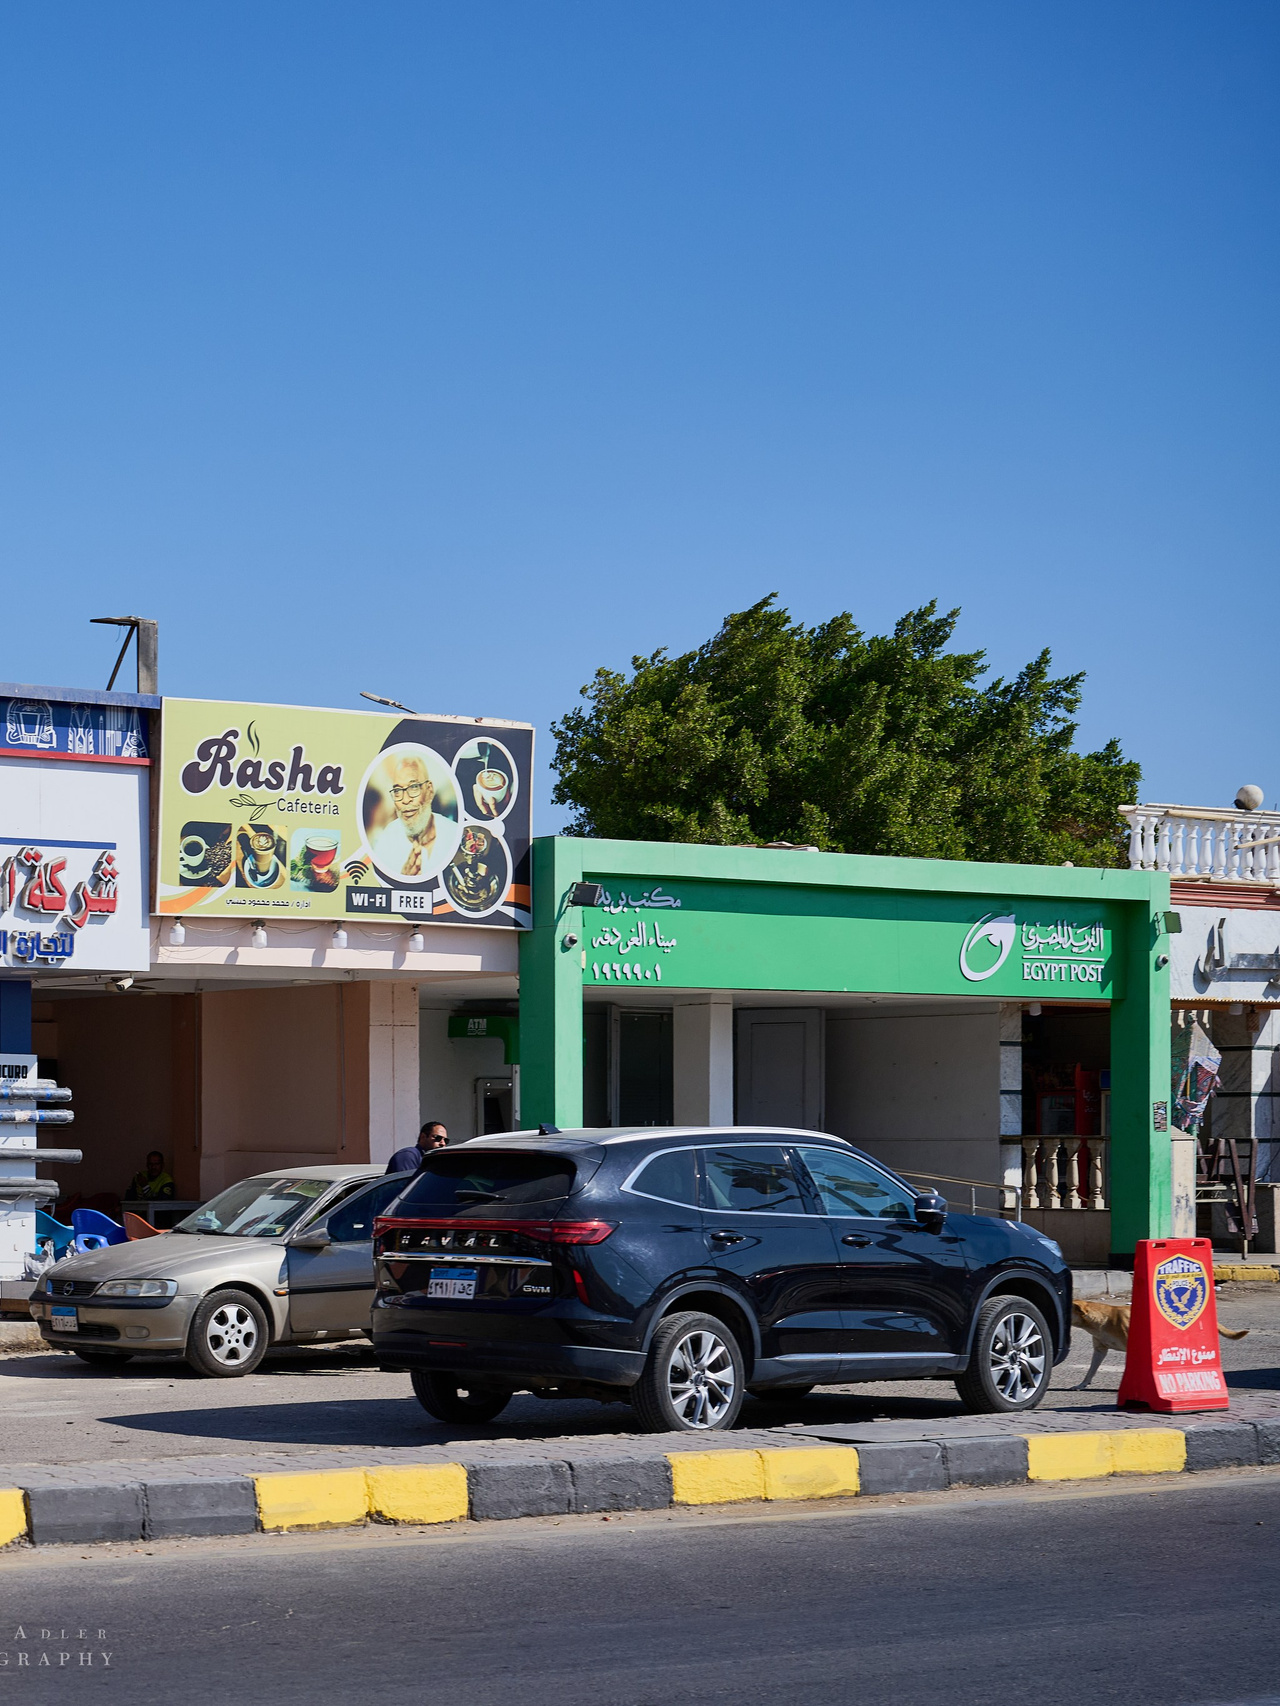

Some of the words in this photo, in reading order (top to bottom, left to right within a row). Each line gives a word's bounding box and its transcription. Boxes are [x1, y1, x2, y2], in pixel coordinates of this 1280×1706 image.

[181, 728, 345, 796] Rasha
[276, 797, 340, 816] Cafeteria
[17, 847, 119, 928] شركة
[351, 892, 387, 908] WI-FI
[398, 895, 425, 909] FREE
[628, 887, 681, 913] مكتب
[648, 921, 677, 953] ميناء
[1022, 962, 1067, 981] EGYPT
[1070, 964, 1104, 982] POST
[468, 1018, 487, 1029] ATM
[1158, 1259, 1200, 1274] TRAFFIC
[523, 1284, 551, 1293] GWM
[1158, 1372, 1177, 1394] NO
[1177, 1370, 1221, 1391] PARKING
